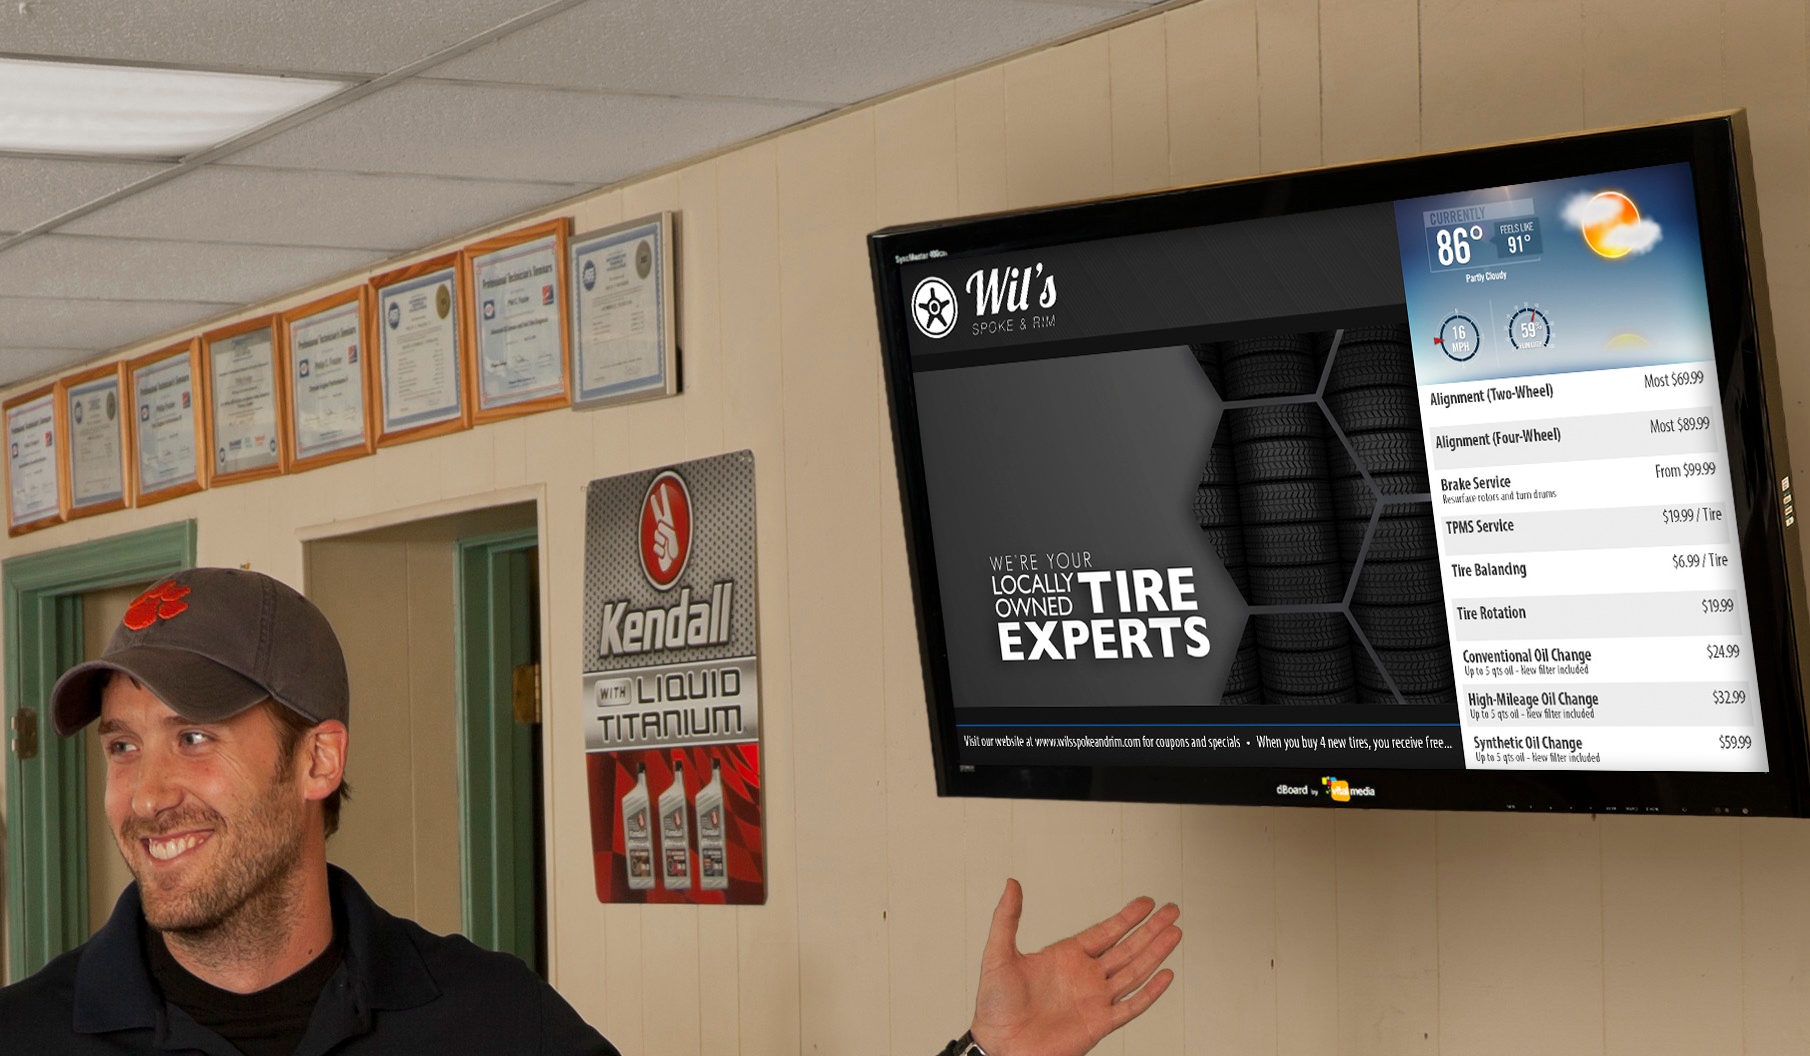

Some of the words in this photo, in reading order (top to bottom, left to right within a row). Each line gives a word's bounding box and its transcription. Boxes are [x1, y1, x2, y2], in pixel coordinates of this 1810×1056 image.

[1430, 207, 1485, 225] CURRENTLY
[1500, 222, 1519, 234] FEELS
[1519, 221, 1534, 232] LIKE
[1437, 225, 1483, 266] 86°
[1508, 234, 1531, 254] 91°
[1466, 272, 1484, 284] Partly
[1486, 270, 1507, 282] Cloudy
[965, 262, 1057, 317] Wil's
[972, 319, 1014, 336] SPOKE
[1019, 318, 1028, 330] &
[1033, 315, 1057, 329] RIM
[1453, 325, 1466, 340] 16
[1452, 340, 1470, 353] MPH
[1644, 374, 1670, 389] Most
[1671, 370, 1704, 387] $69.99
[1430, 387, 1485, 409] Alignment
[1487, 383, 1554, 404] (Two-Wheel)
[1650, 418, 1675, 434] Most
[1677, 416, 1710, 432] $89.99
[1435, 430, 1490, 450] Alignment
[1492, 427, 1561, 447] (Four-Wheel)
[1655, 463, 1681, 479] From
[1682, 461, 1716, 478] $99.99
[1441, 477, 1471, 492] Brake
[1473, 475, 1511, 491] Service
[1443, 492, 1477, 505] Resurface
[1478, 491, 1500, 503] rotors
[1501, 490, 1514, 501] and
[1515, 490, 1532, 500] turn
[1533, 488, 1557, 500] drums
[1662, 508, 1694, 525] $19.99
[1696, 508, 1701, 524] /
[1702, 507, 1722, 522] Tire
[1446, 520, 1475, 535] TPMS
[1477, 518, 1514, 534] Service
[990, 553, 1038, 571] WE'RE
[1047, 551, 1092, 569] YOUR
[1672, 554, 1700, 570] $6.99
[1702, 553, 1707, 569] /
[1708, 553, 1728, 568] Tire
[1451, 563, 1472, 578] Tire
[1474, 562, 1527, 580] Balancing
[992, 572, 1074, 596] LOCALLY
[1078, 567, 1199, 614] TIRE
[995, 597, 1073, 618] OWNED
[1457, 606, 1477, 621] Tire
[1480, 605, 1526, 620] Rotation
[1702, 598, 1734, 615] $19.99
[600, 581, 733, 656] Kendall
[998, 616, 1211, 661] EXPERTS
[1463, 648, 1532, 664] Conventional
[1534, 648, 1549, 663] Oil
[1551, 648, 1592, 665] Change
[1707, 644, 1740, 660] $24.99
[1465, 665, 1474, 678] Up
[1475, 665, 1483, 676] to
[1485, 664, 1491, 676] 5
[1492, 665, 1503, 678] qts
[1504, 664, 1514, 676] oil
[1521, 664, 1536, 676] New
[1537, 664, 1556, 675] filter
[1557, 663, 1589, 675] included
[599, 686, 626, 700] WITH
[637, 669, 741, 704] LIQUID
[1468, 692, 1539, 710] High-Mileage
[1541, 692, 1556, 706] Oil
[1558, 692, 1599, 708] Change
[1712, 690, 1746, 705] $32.99
[1470, 709, 1479, 721] Up
[1480, 709, 1489, 719] to
[1490, 708, 1496, 719] 5
[1498, 709, 1509, 721] qts
[1510, 708, 1520, 719] oil
[1526, 708, 1542, 719] New
[1543, 708, 1562, 719] filter
[1563, 707, 1594, 719] included
[597, 706, 742, 741] TITANIUM
[963, 734, 979, 748] Visit
[980, 737, 994, 748] our
[995, 735, 1025, 749] website
[1026, 736, 1034, 749] at
[1035, 735, 1141, 752] www.wilsspokeandrim.com
[1142, 735, 1154, 749] for
[1155, 738, 1189, 752] coupons
[1190, 735, 1206, 749] and
[1208, 735, 1241, 752] specials
[1257, 735, 1278, 750] When
[1280, 738, 1297, 753] you
[1299, 735, 1318, 753] buy
[1320, 736, 1327, 750] 4
[1328, 739, 1347, 750] new
[1348, 736, 1371, 752] tires,
[1373, 739, 1389, 753] you
[1390, 737, 1421, 751] receive
[1422, 736, 1453, 751] free...
[1473, 736, 1524, 752] Synthetic
[1526, 737, 1541, 750] Oil
[1542, 736, 1582, 752] Change
[1719, 735, 1752, 750] $59.99
[1476, 752, 1485, 764] Up
[1486, 752, 1494, 762] to
[1496, 752, 1502, 762] 5
[1503, 753, 1514, 765] qts
[1515, 752, 1525, 762] oil
[1532, 752, 1548, 763] New
[1549, 752, 1567, 763] filter
[1568, 751, 1600, 763] included
[1277, 784, 1309, 797] dBoard
[1311, 788, 1319, 797] by
[1331, 785, 1349, 798] vital
[1350, 786, 1376, 797] media
